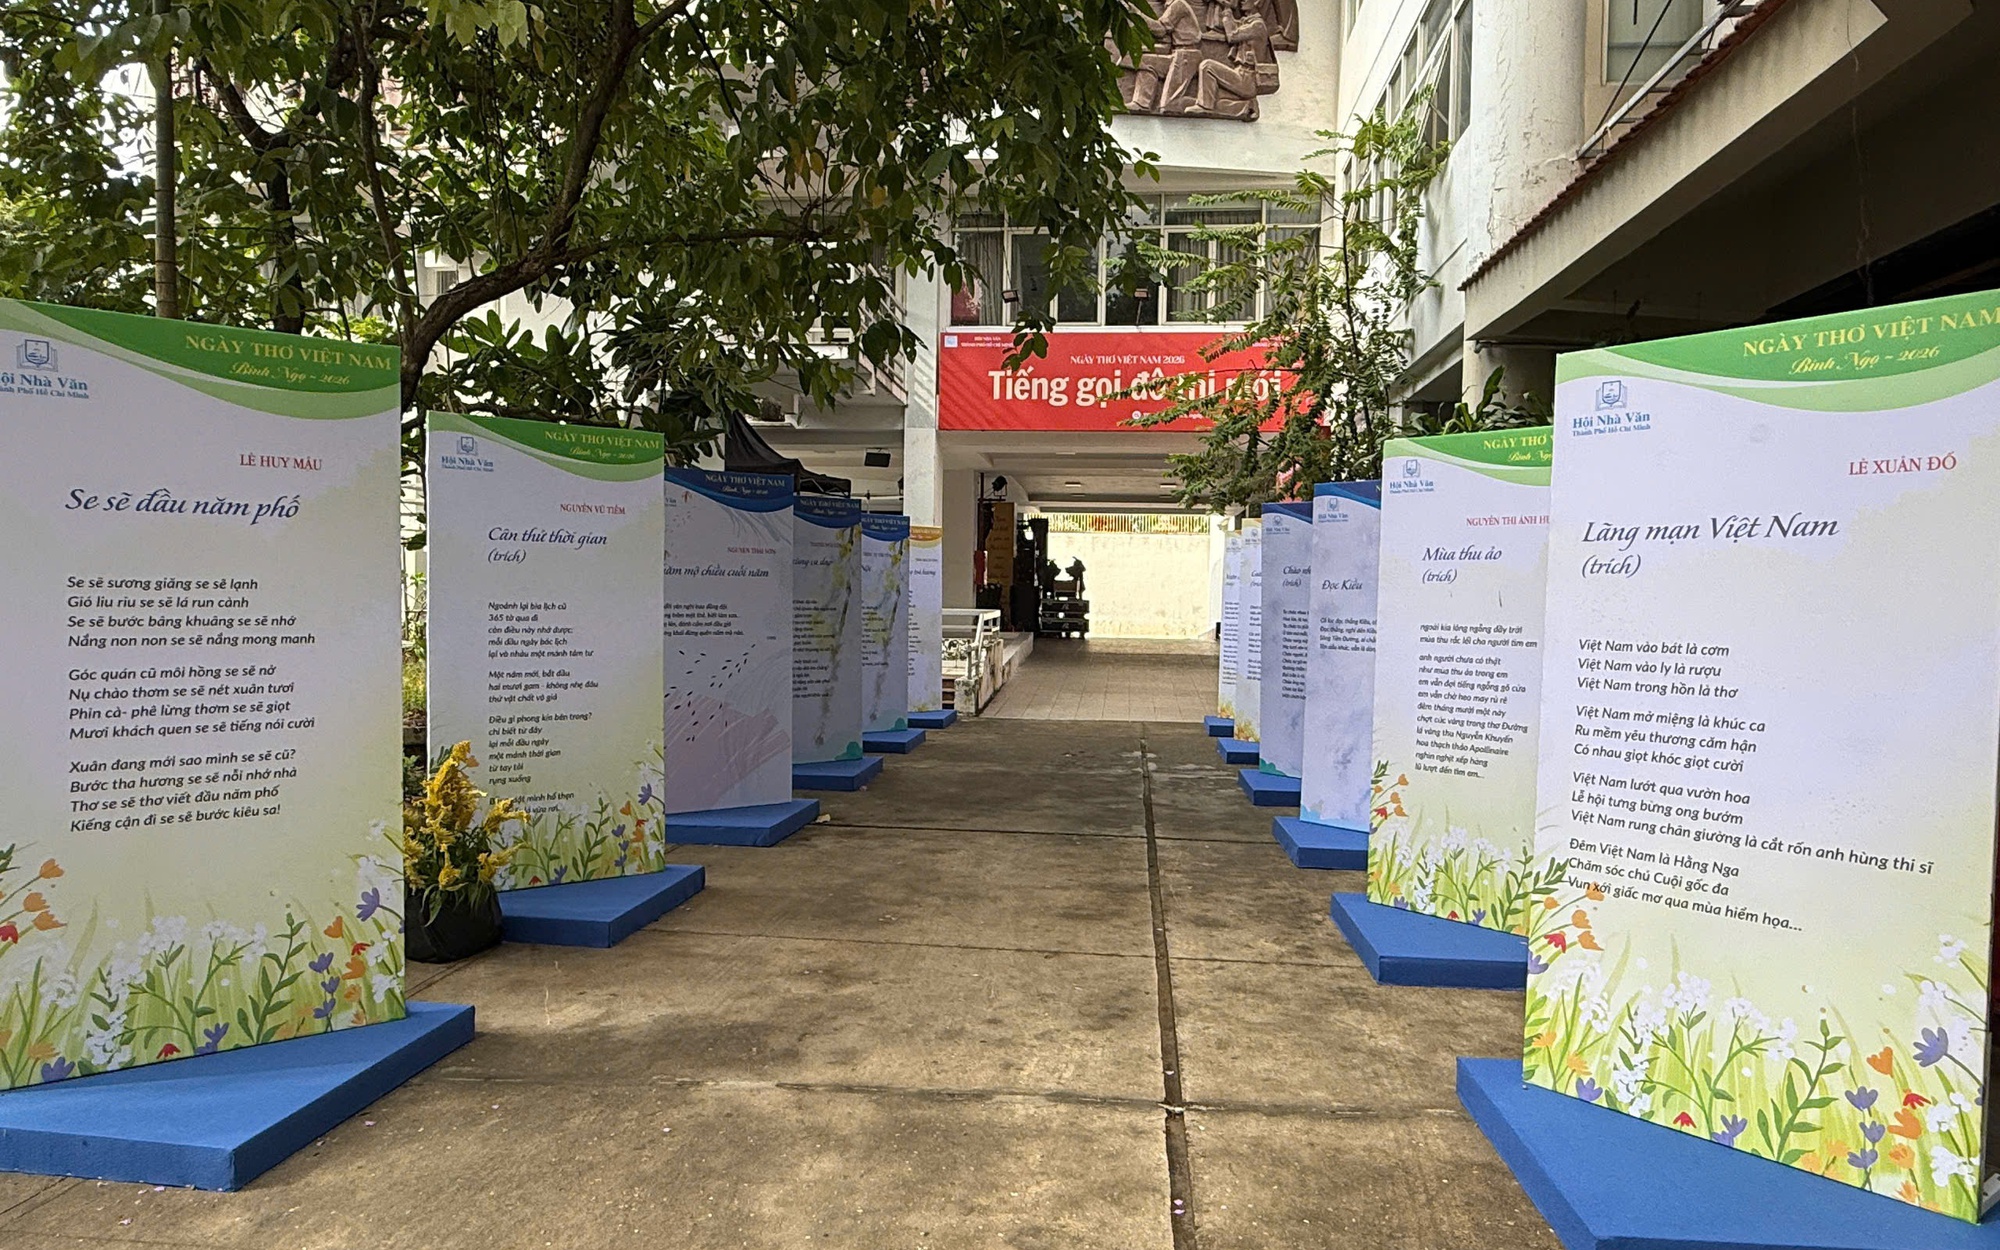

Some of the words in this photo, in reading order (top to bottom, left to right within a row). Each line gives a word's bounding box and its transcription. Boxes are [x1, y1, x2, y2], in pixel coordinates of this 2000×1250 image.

[1743, 333, 1804, 357] NGÀY
[1816, 323, 1865, 347] THƠ
[1874, 317, 1929, 340] VIỆT
[1940, 306, 2000, 332] NAM
[185, 335, 242, 354] NGÀY
[253, 342, 294, 360] THƠ
[300, 348, 341, 367] VIỆT
[348, 353, 391, 370] NAM
[1070, 354, 1094, 365] NGÀY
[1097, 354, 1117, 365] THƠ
[1117, 354, 1138, 365] VIỆT
[1140, 355, 1163, 364] NAM
[1162, 355, 1185, 364] 2026
[0, 372, 15, 386] ội
[20, 373, 52, 388] Nhà
[58, 377, 88, 391] Văn
[988, 366, 1070, 407] Tiếng
[1075, 369, 1122, 408] gọi
[1573, 416, 1593, 429] Hội
[1597, 413, 1621, 426] Nhà
[1626, 411, 1650, 423] Văn
[1483, 437, 1516, 450] NGÀY
[1520, 434, 1547, 446] THƠ
[240, 452, 256, 467] LÊ
[260, 455, 289, 468] HUY
[1848, 458, 1868, 476] LÊ
[1872, 455, 1922, 474] XUÂN
[64, 488, 100, 510] Se
[102, 492, 132, 511] sẽ
[135, 489, 186, 514] đầu
[192, 496, 249, 516] năm
[252, 494, 300, 525] phố
[1582, 521, 1640, 551] Lãng
[1645, 524, 1700, 545] mạn
[1712, 514, 1761, 543] Việt
[1764, 512, 1839, 538] Nam
[487, 547, 527, 564] (trích)
[1422, 547, 1456, 561] Mùa
[1458, 544, 1482, 560] thu
[1484, 546, 1502, 560] ảo
[1581, 554, 1641, 578] (trích)
[1321, 579, 1340, 592] Đọc
[1340, 578, 1363, 591] Kiều
[1422, 568, 1458, 584] (trích)
[1578, 638, 1602, 653] Việt
[1604, 640, 1633, 652] Nam
[1636, 641, 1658, 653] vào
[1660, 641, 1683, 655] bát
[1685, 642, 1698, 655] là
[1700, 645, 1730, 657] cơm
[1573, 743, 1590, 755] Có
[1591, 745, 1622, 759] nhau
[1623, 748, 1649, 764] giọt
[1650, 750, 1682, 766] khóc
[1683, 754, 1710, 770] giọt
[1712, 759, 1744, 772] cười
